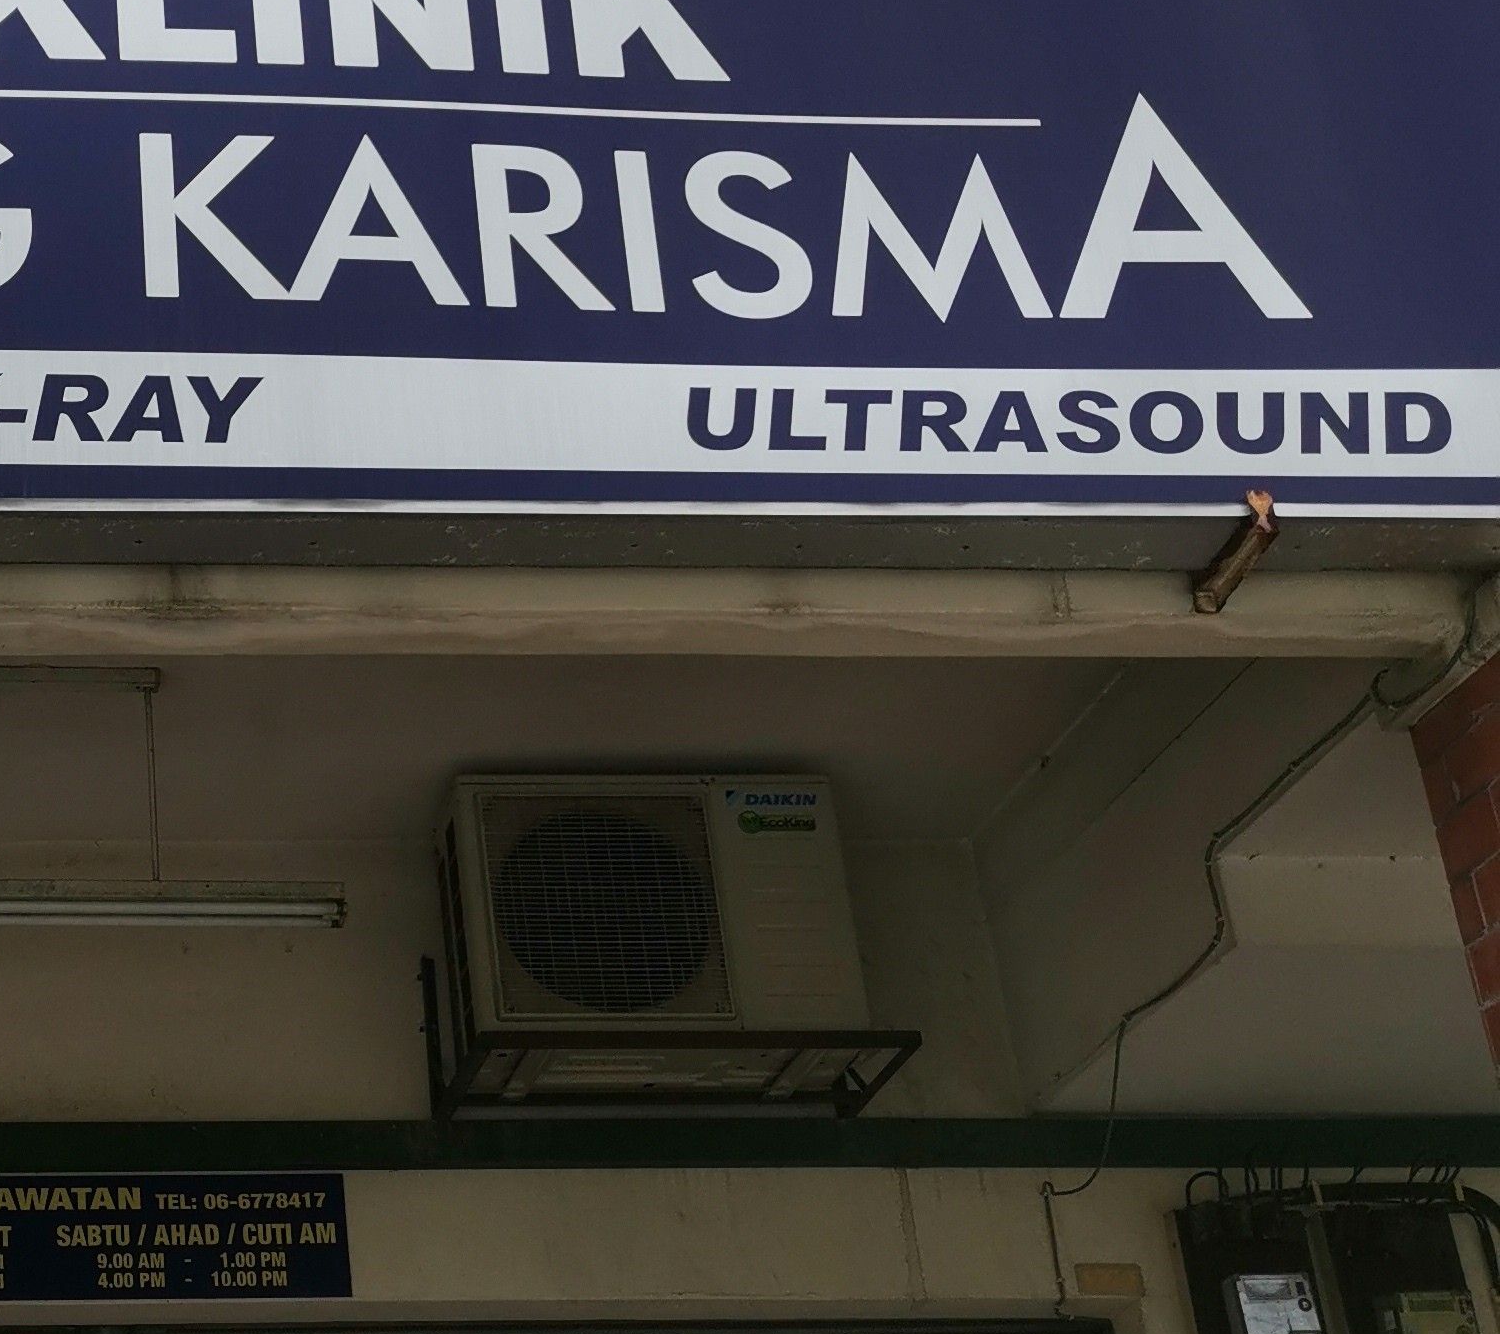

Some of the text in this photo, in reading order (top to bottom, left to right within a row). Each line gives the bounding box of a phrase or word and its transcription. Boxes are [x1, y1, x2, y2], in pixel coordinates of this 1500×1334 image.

[138, 92, 1313, 322] KARISMA
[684, 385, 1454, 457] ULTRASOUND
[745, 794, 816, 805] DAIKIN
[155, 1193, 197, 1210] TEL:
[203, 1192, 326, 1210] 06-6778417
[56, 1222, 337, 1247] SABTU AHAD CUTI AM
[97, 1252, 286, 1269] 9.00 AM 1.00 PM
[97, 1271, 287, 1288] 4.00 PM 10.00 PM
